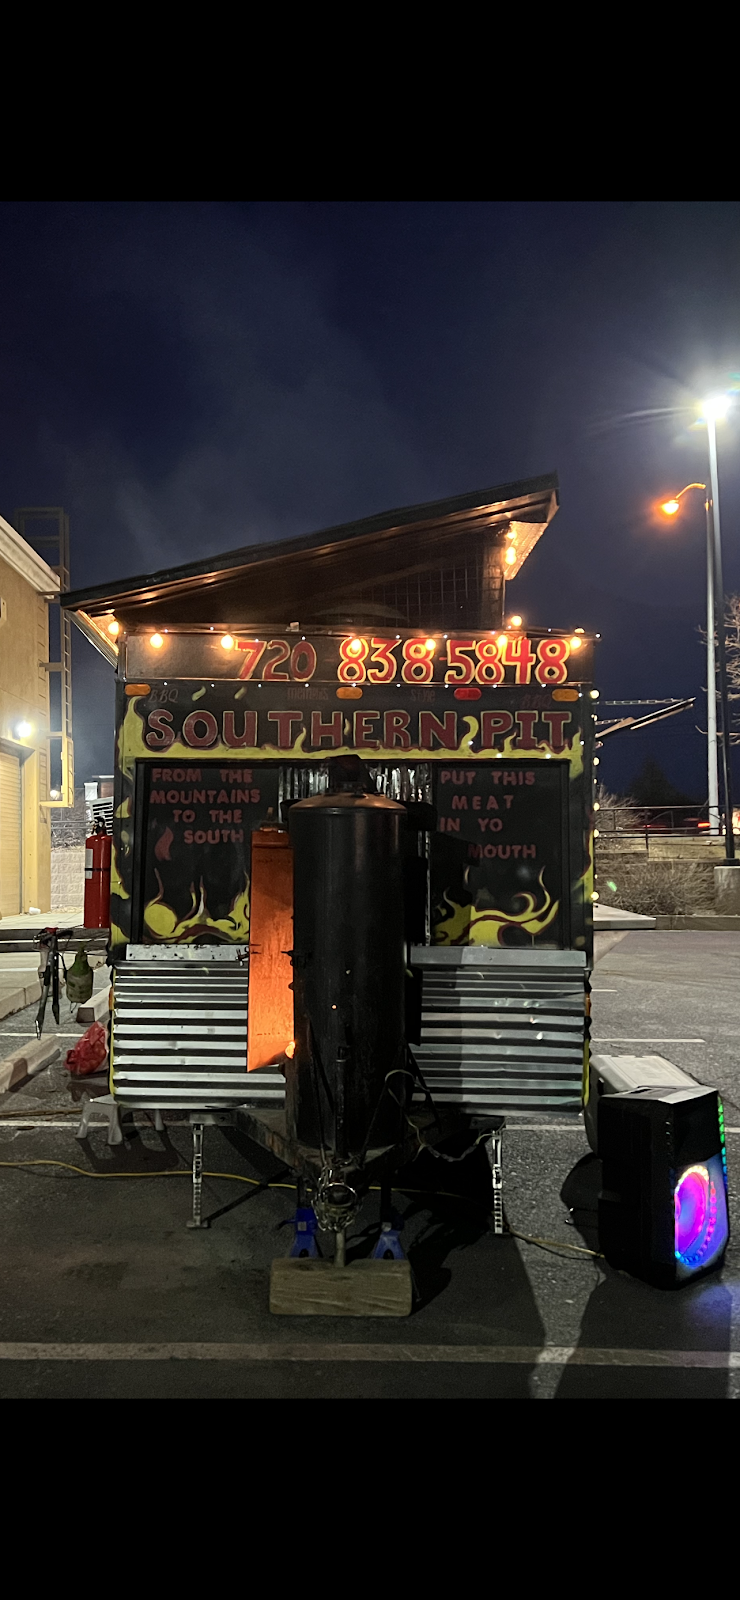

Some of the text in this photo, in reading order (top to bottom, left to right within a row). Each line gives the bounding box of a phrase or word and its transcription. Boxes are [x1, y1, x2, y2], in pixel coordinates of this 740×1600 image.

[233, 639, 318, 681] 720
[148, 688, 178, 704] BBQ
[146, 709, 572, 748] SOUTHERN PIT
[152, 768, 253, 784] FROM THE
[440, 770, 536, 786] PUT THIS
[150, 789, 261, 804] MOUNTAINS
[452, 795, 514, 810] MEAT
[173, 809, 243, 824] TO THE
[440, 817, 503, 832] IN YO
[184, 829, 244, 844] SOUTH
[468, 844, 537, 859] MOUTH
